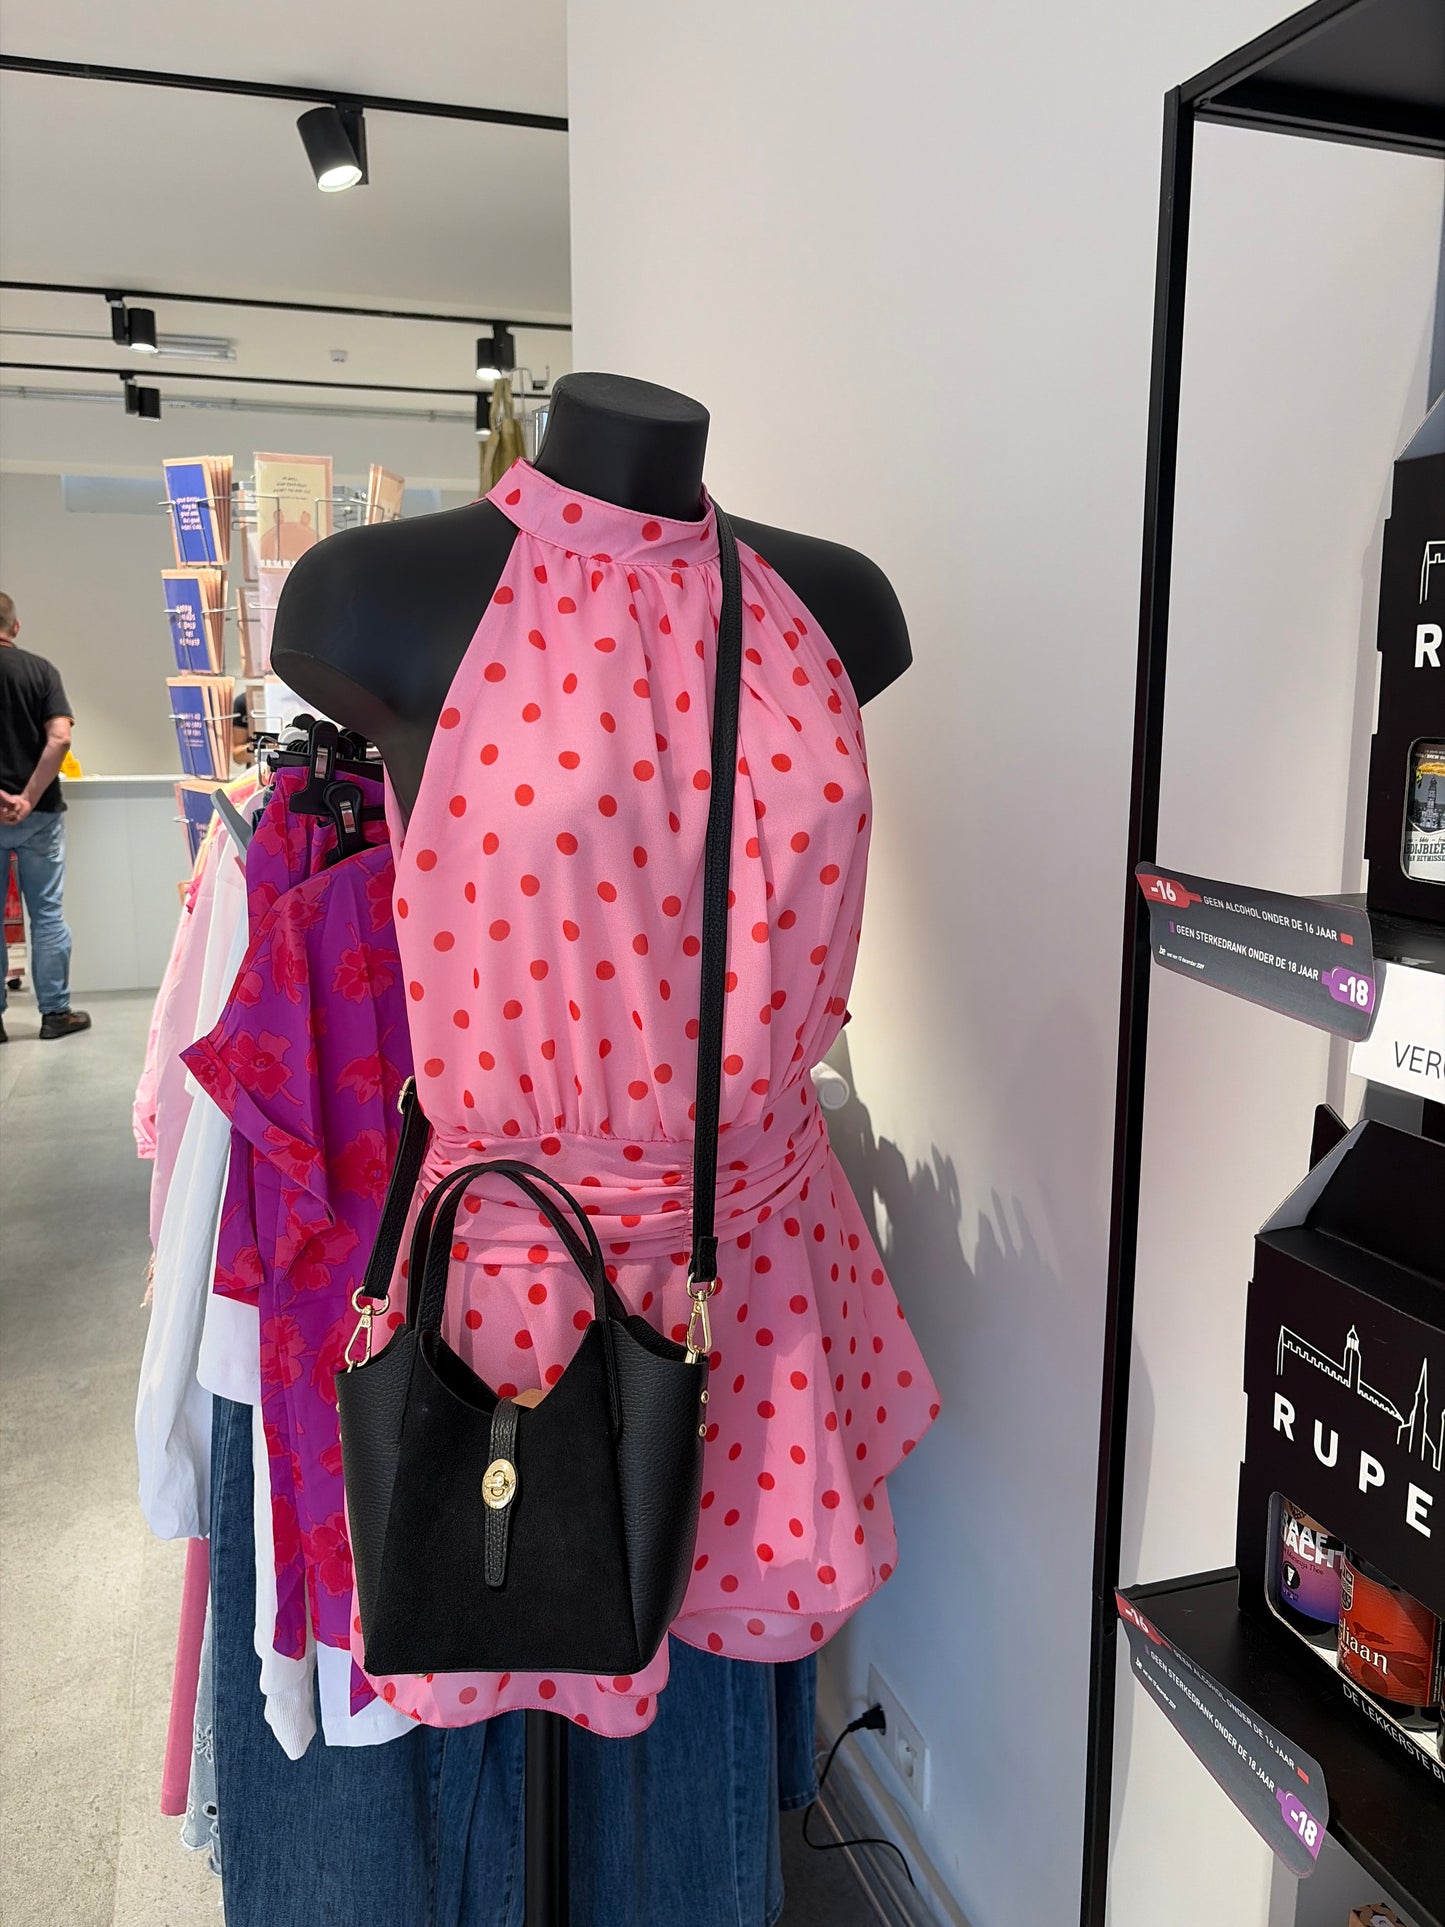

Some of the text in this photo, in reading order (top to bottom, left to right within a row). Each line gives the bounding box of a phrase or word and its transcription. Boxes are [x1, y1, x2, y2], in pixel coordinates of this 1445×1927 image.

[1151, 880, 1176, 902] -16
[1203, 896, 1338, 941] GEEN ALCOHOL ONDER DE 16 JAAR
[1176, 924, 1319, 981] GEEN STERKEDRANK ONDER DE 18 JAAR
[1339, 976, 1369, 1006] -18
[1395, 1040, 1445, 1079] VER
[1273, 1392, 1434, 1538] RUPE
[1125, 1608, 1149, 1633] -16
[1151, 1651, 1168, 1672] GEEN
[1168, 1668, 1214, 1724] STERKEDRANK
[1214, 1718, 1237, 1750] ONDER
[1237, 1744, 1247, 1761] DE
[1248, 1756, 1256, 1771] 18
[1256, 1767, 1275, 1793] JAAR
[1226, 1699, 1253, 1728] ONDER
[1253, 1723, 1264, 1739] DE
[1265, 1735, 1274, 1749] 16
[1275, 1746, 1295, 1770] JAAR
[1343, 1683, 1360, 1707] DE
[1361, 1700, 1431, 1770] LEKKERSTE
[1290, 1809, 1318, 1847] -18
